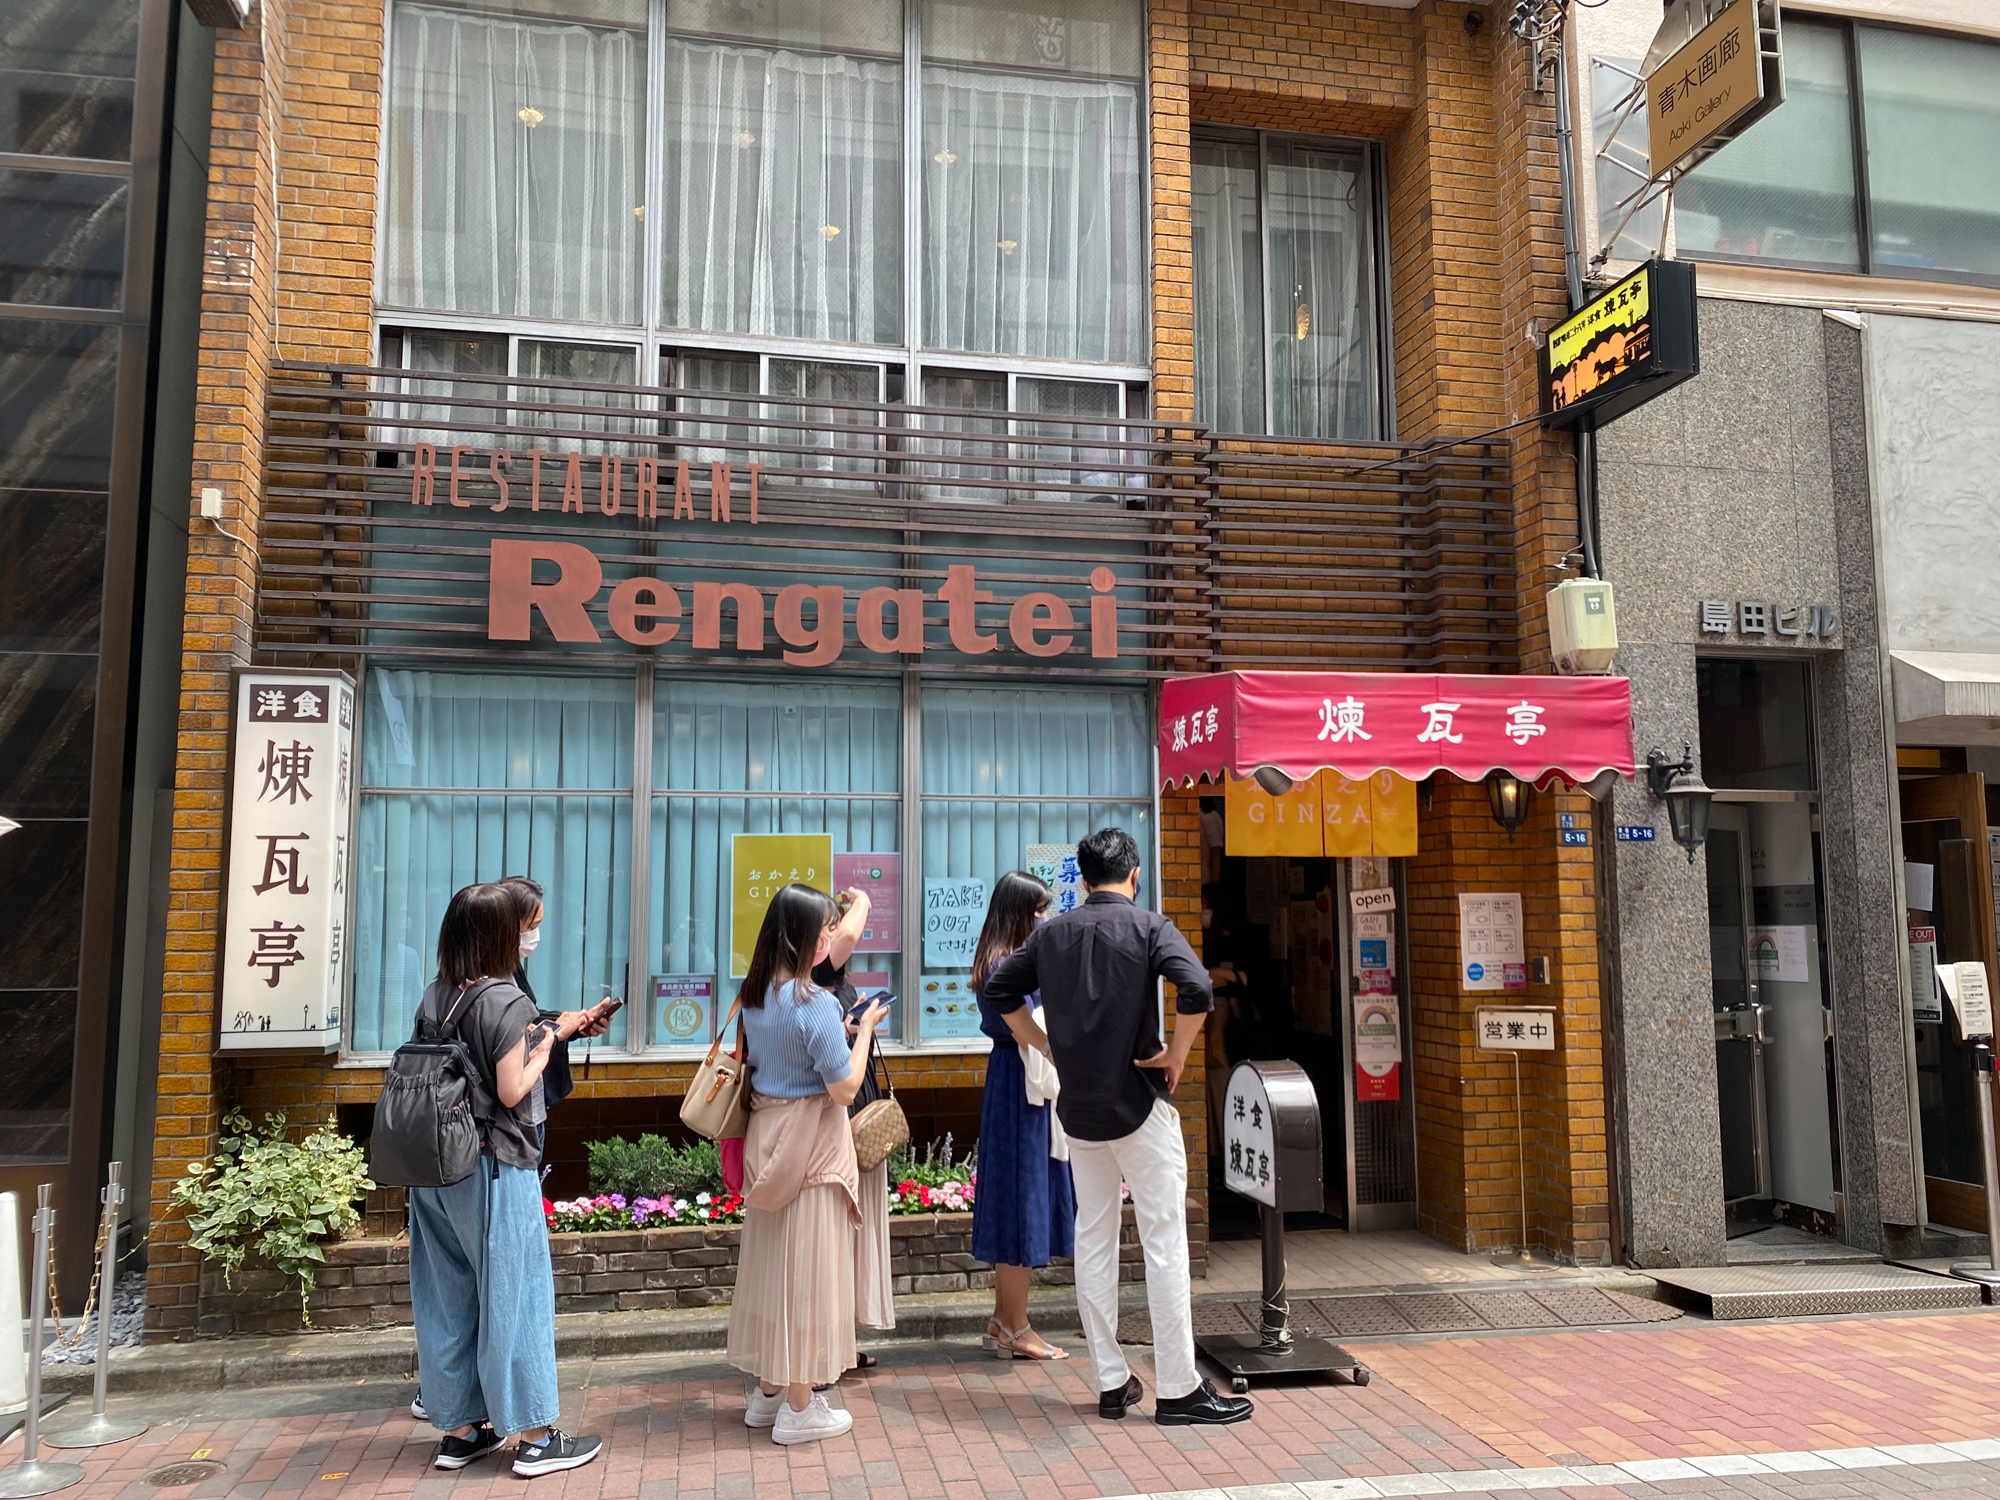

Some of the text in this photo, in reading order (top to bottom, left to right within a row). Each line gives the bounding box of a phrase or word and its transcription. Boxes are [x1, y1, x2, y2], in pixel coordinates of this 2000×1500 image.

[1658, 26, 1740, 119] 青木画廊
[1669, 85, 1732, 146] Aoki Gallery
[1604, 280, 1642, 317] 煉瓦亭
[411, 442, 764, 524] RESTAURANT
[487, 538, 1119, 667] Rengatei
[1701, 600, 1841, 636] 島田ビル
[256, 689, 322, 719] 洋食
[1172, 704, 1219, 753] 煉瓦亭
[1317, 696, 1547, 745] 煉瓦亭
[1248, 802, 1371, 824] GINZA
[1565, 833, 1586, 842] 5-16
[1632, 828, 1653, 838] 5-16
[247, 738, 315, 989] 煉瓦亭
[748, 868, 815, 881] おかえり
[928, 885, 983, 909] TAKE
[1355, 892, 1391, 909] open
[928, 914, 971, 933] OUT
[1360, 916, 1379, 924] CASH
[1363, 924, 1382, 932] ONLY
[1915, 929, 1932, 938] OUT
[673, 1008, 693, 1028] 優
[1485, 1020, 1548, 1041] 営業中
[1233, 1095, 1263, 1130] 洋食
[1230, 1138, 1270, 1187] 煉瓦亭
